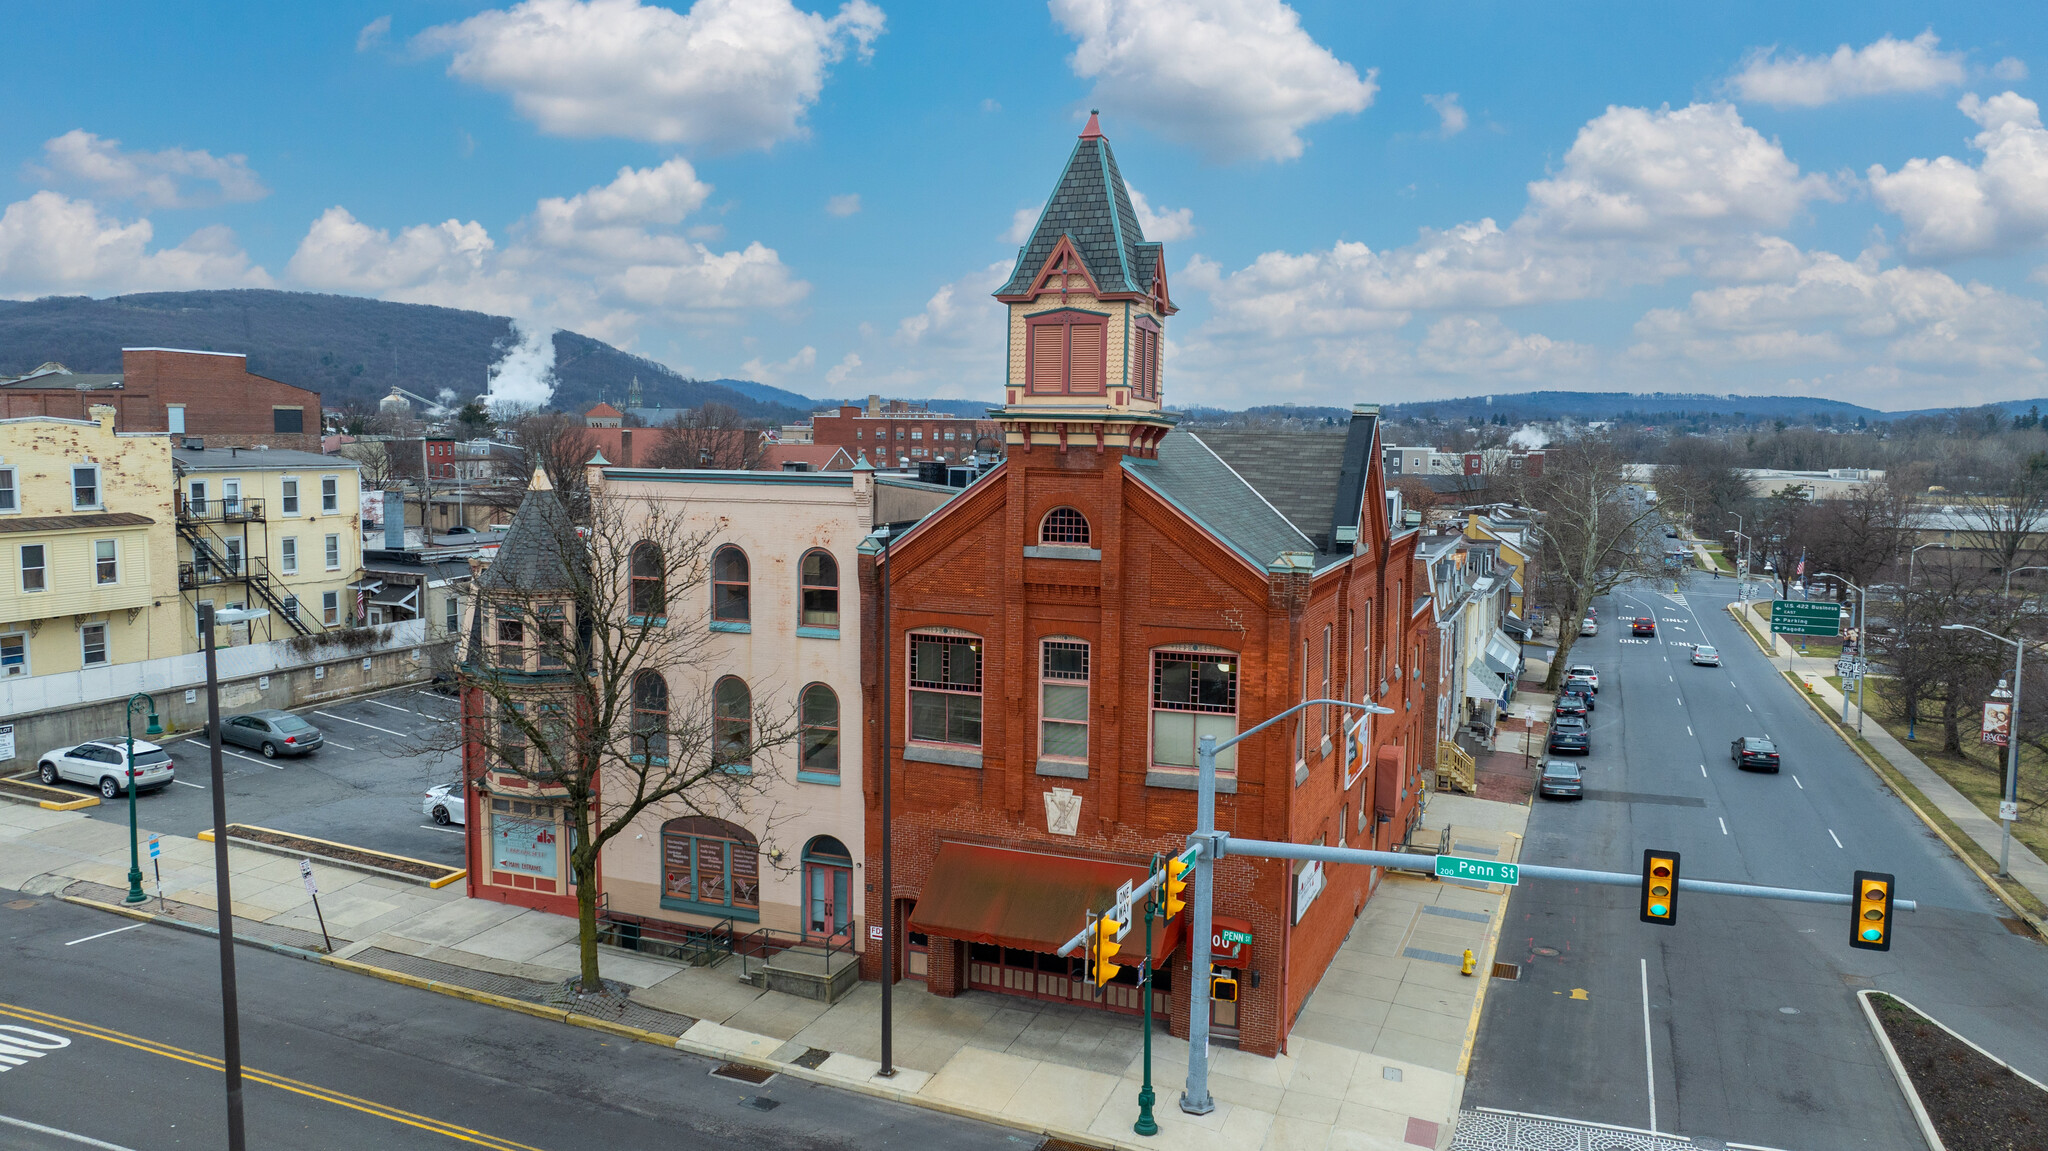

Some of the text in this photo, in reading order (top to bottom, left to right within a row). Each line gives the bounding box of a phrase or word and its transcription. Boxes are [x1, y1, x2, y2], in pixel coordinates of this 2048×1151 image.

[1838, 662, 1852, 670] 422
[1440, 861, 1515, 879] 200 Penn St
[1119, 886, 1130, 905] ONE
[1119, 900, 1130, 919] WAY
[1223, 930, 1244, 942] PENN
